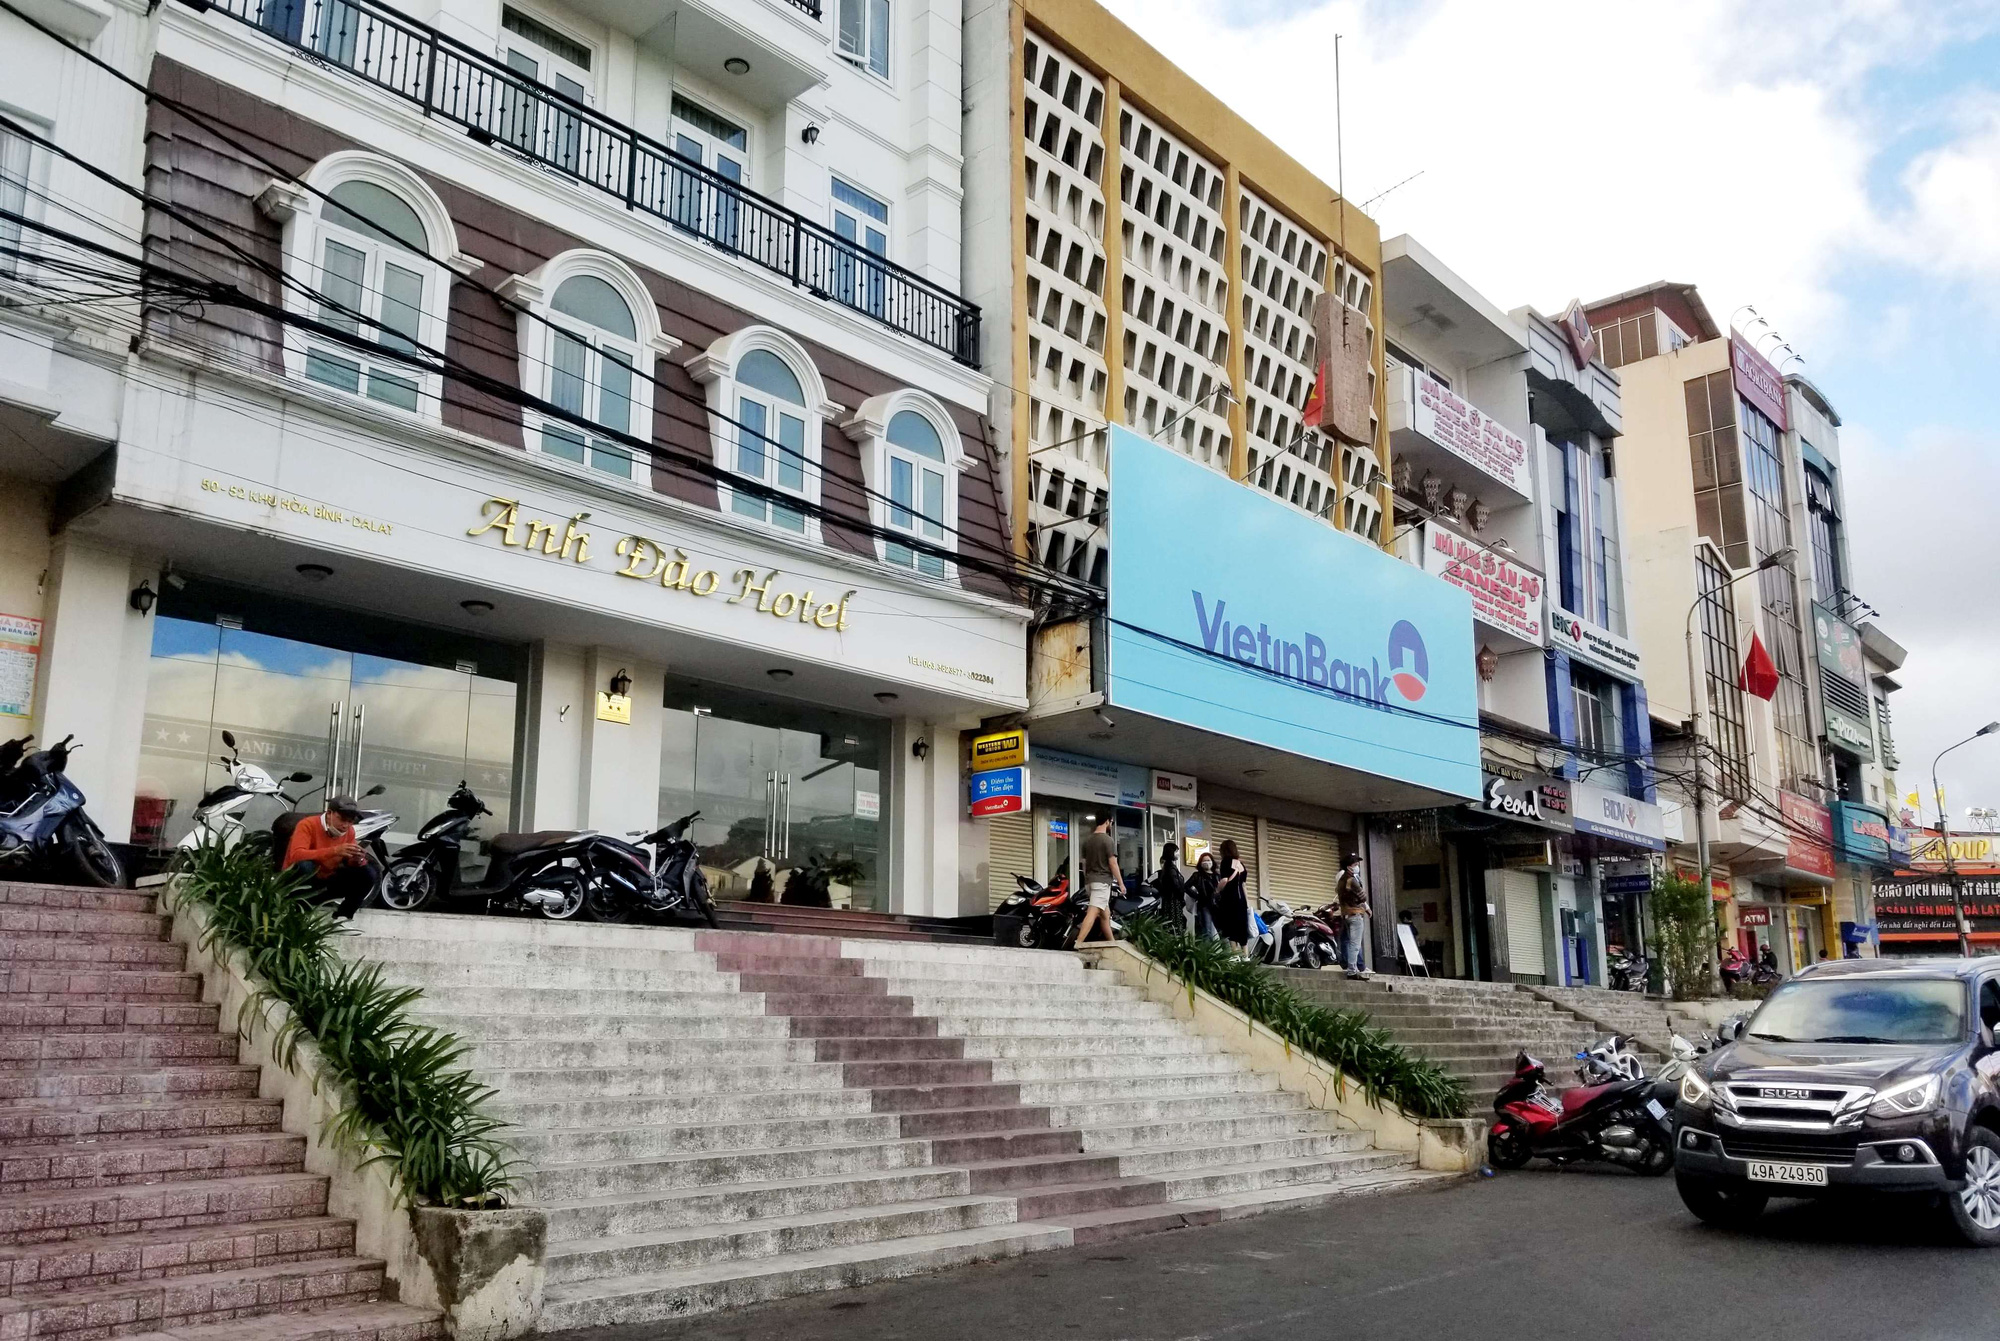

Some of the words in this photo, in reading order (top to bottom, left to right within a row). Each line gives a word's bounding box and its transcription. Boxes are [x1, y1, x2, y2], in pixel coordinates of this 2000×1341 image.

[201, 478, 219, 493] 50
[228, 486, 245, 500] 52
[248, 489, 277, 508] KHU
[280, 496, 310, 516] HÒA
[314, 504, 343, 523] BÌNH
[352, 516, 395, 536] DALAT
[466, 497, 595, 564] Anh
[614, 535, 721, 597] Đào
[727, 567, 859, 633] Hotel
[1445, 560, 1527, 608] GANESH
[1191, 589, 1393, 714] VietinBank
[1490, 778, 1545, 820] Seoul
[1603, 798, 1626, 823] BIDV
[1905, 882, 1930, 899] DỊCH
[1931, 881, 1952, 897] NHÀ
[1743, 913, 1766, 924] ATM
[1909, 903, 1932, 915] LIÊN
[1936, 904, 1955, 915] MIN
[1963, 902, 1979, 915] ĐÀ
[1760, 1088, 1810, 1100] ISUZU
[1751, 1164, 1824, 1182] 49A-249.50
